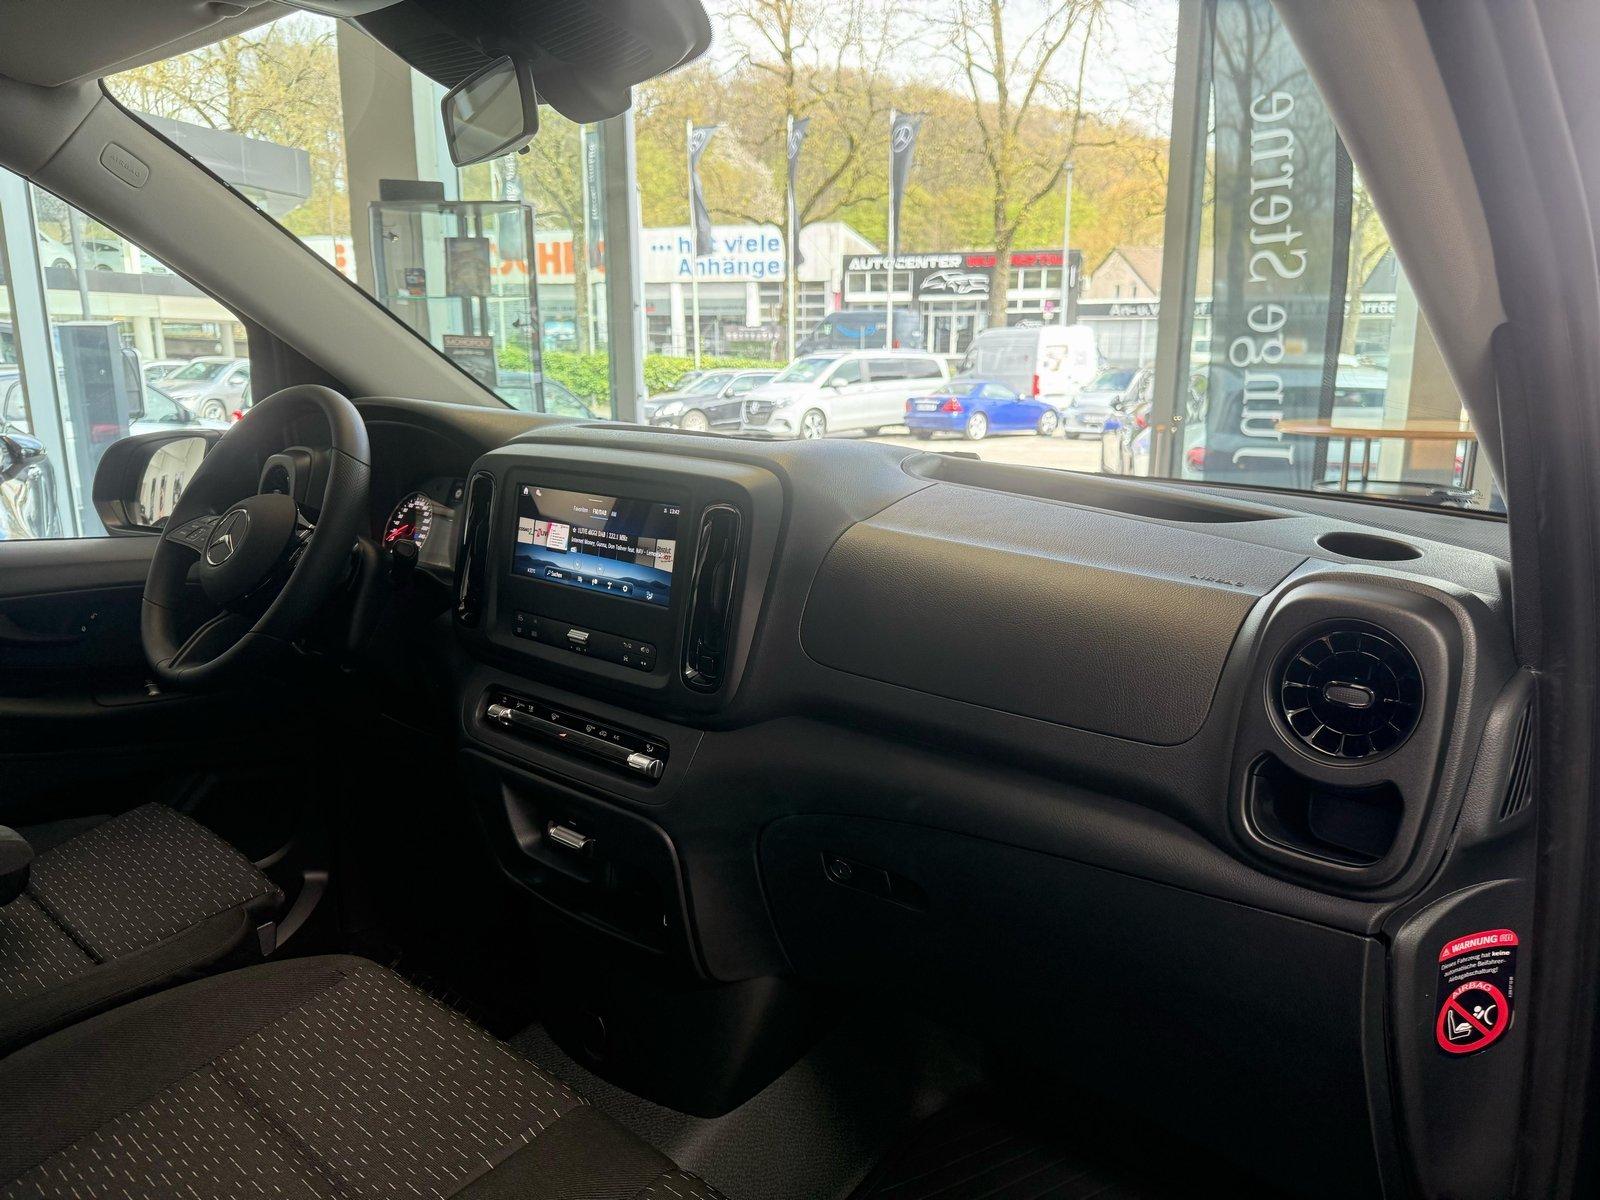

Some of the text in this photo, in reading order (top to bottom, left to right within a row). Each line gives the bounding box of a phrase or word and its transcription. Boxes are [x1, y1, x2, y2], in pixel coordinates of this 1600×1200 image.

[678, 236, 716, 253] ht
[725, 234, 780, 252] viele
[849, 255, 963, 271] AUTOCENTER
[1452, 935, 1498, 952] WARNUNG
[1481, 951, 1491, 959] hat
[1452, 982, 1492, 999] AIRBAG
